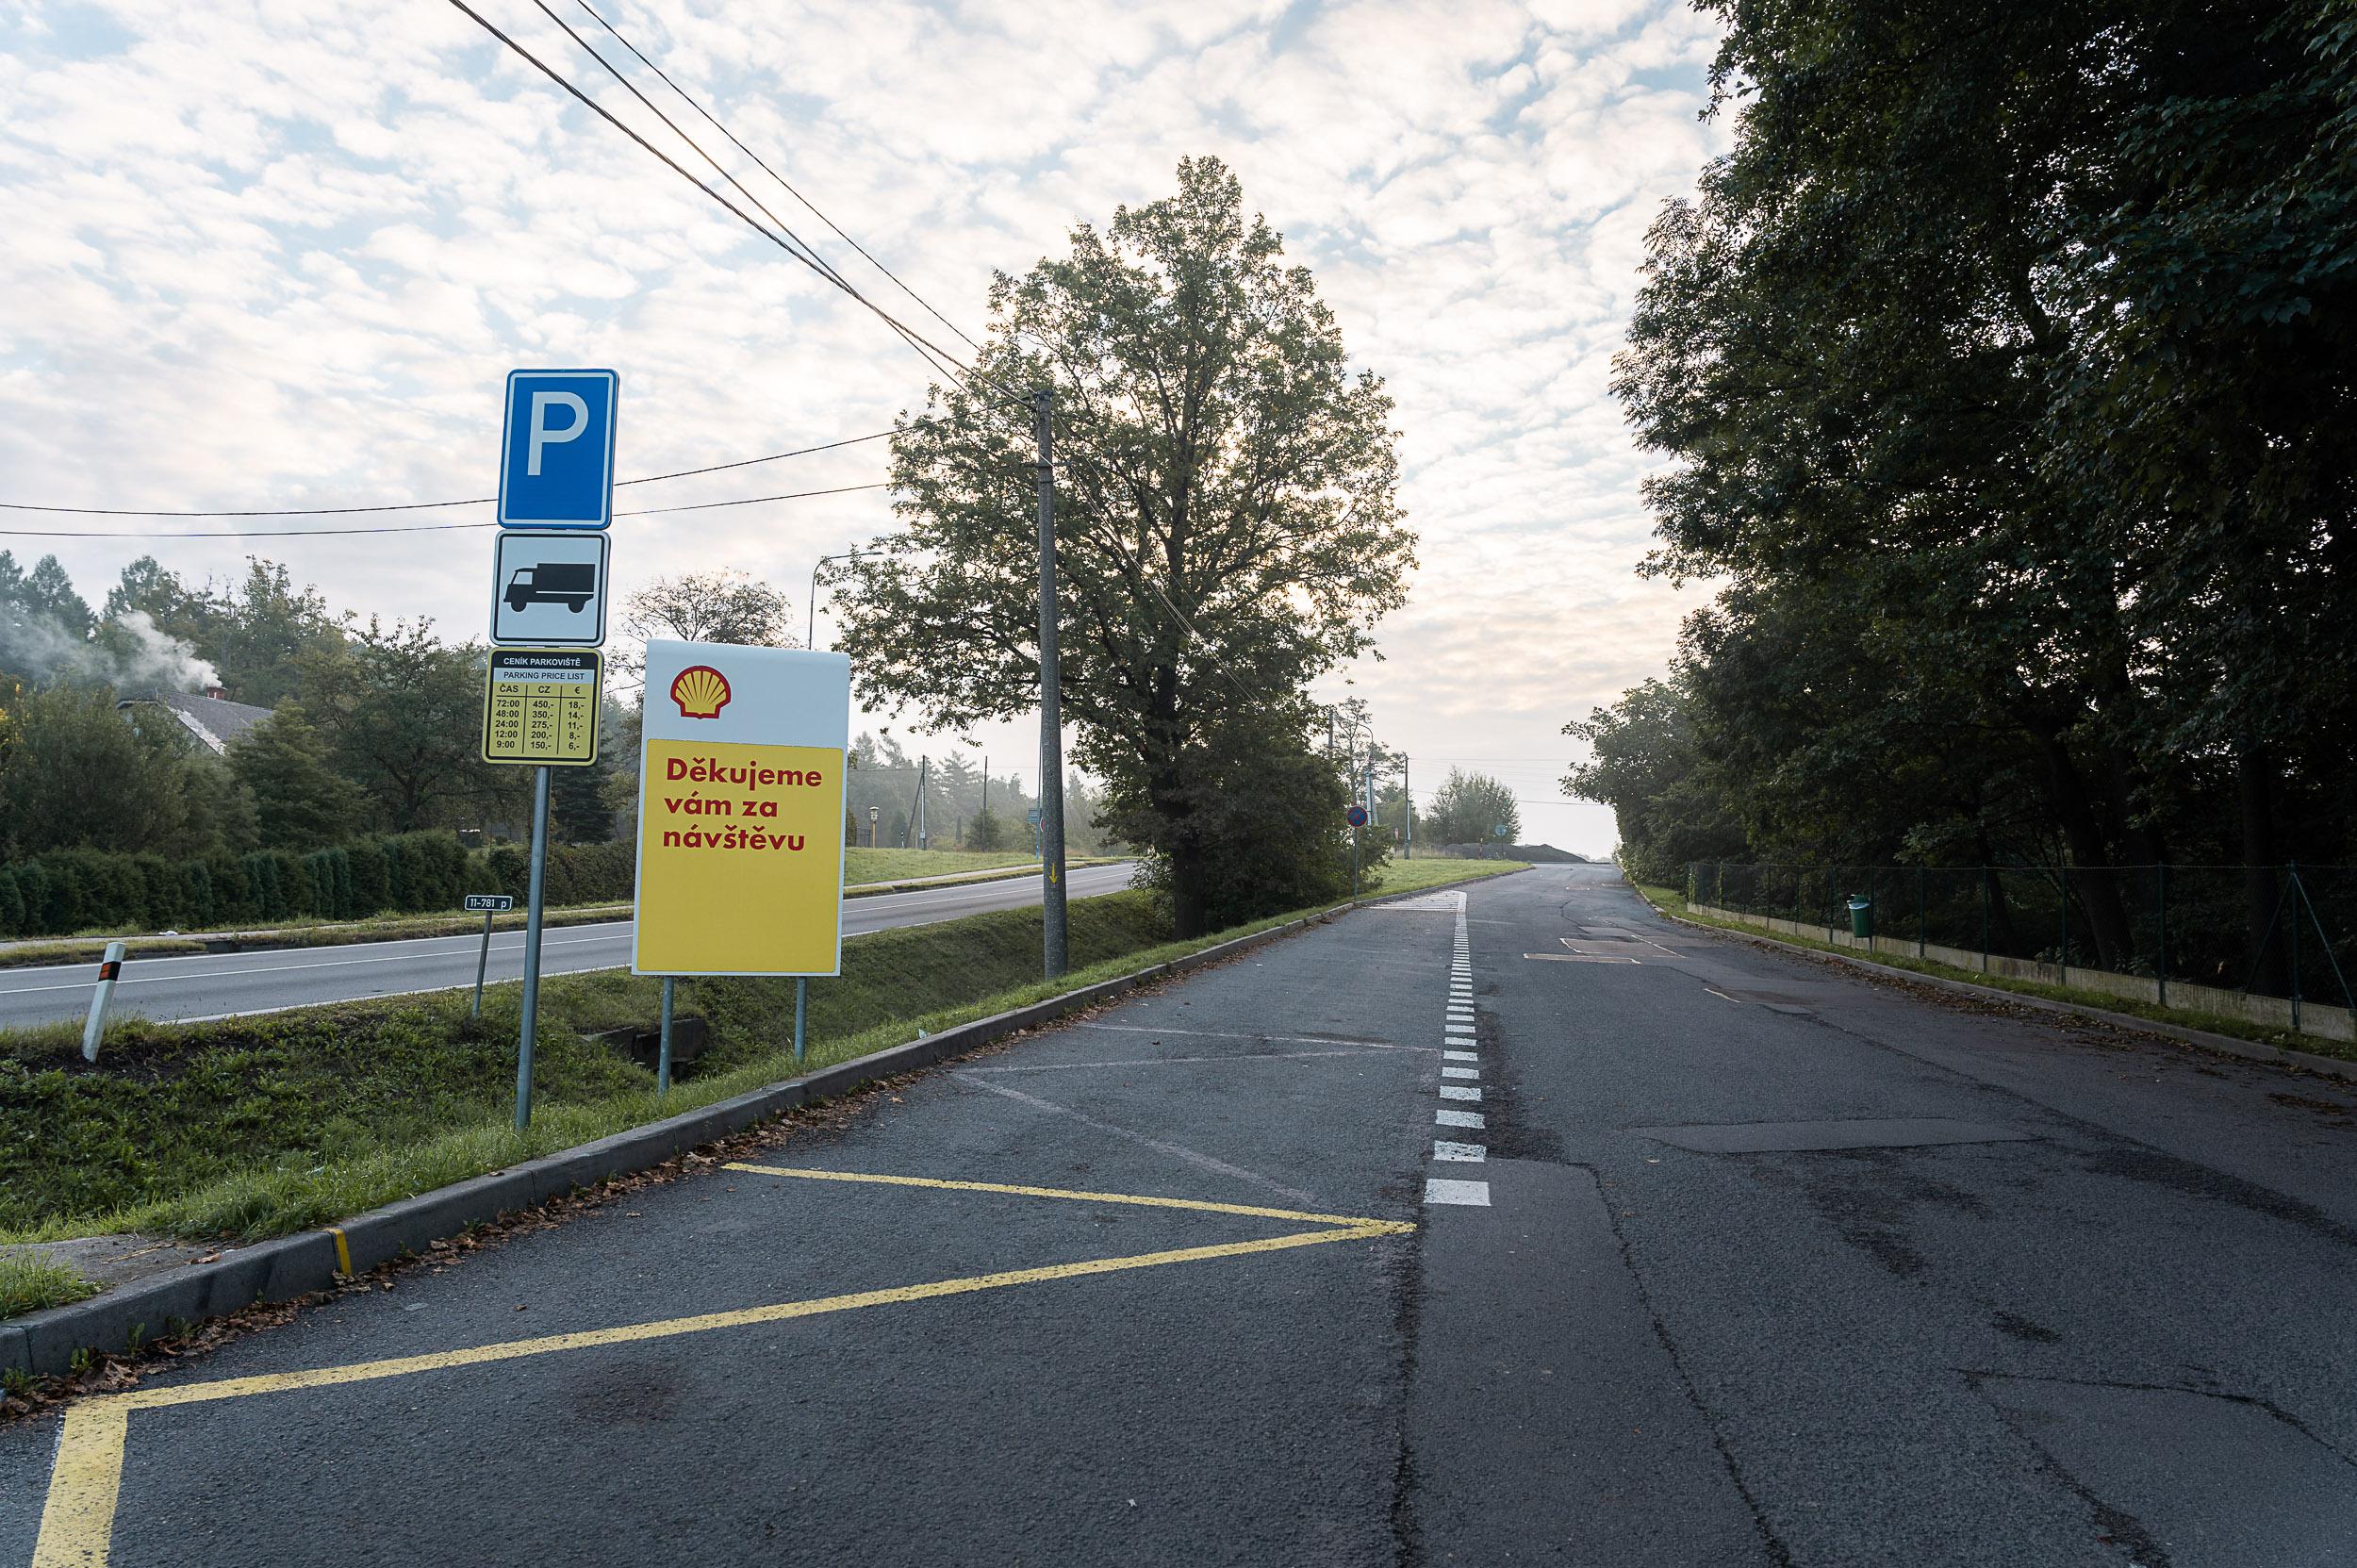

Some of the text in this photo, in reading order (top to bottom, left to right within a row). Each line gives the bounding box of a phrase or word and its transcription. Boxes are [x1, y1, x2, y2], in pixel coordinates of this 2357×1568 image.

[527, 391, 589, 476] P
[500, 684, 519, 692] ČAS
[667, 757, 822, 791] Děkujeme
[665, 791, 777, 817] vám za
[664, 824, 804, 851] návštěvu
[470, 899, 494, 907] 11-781
